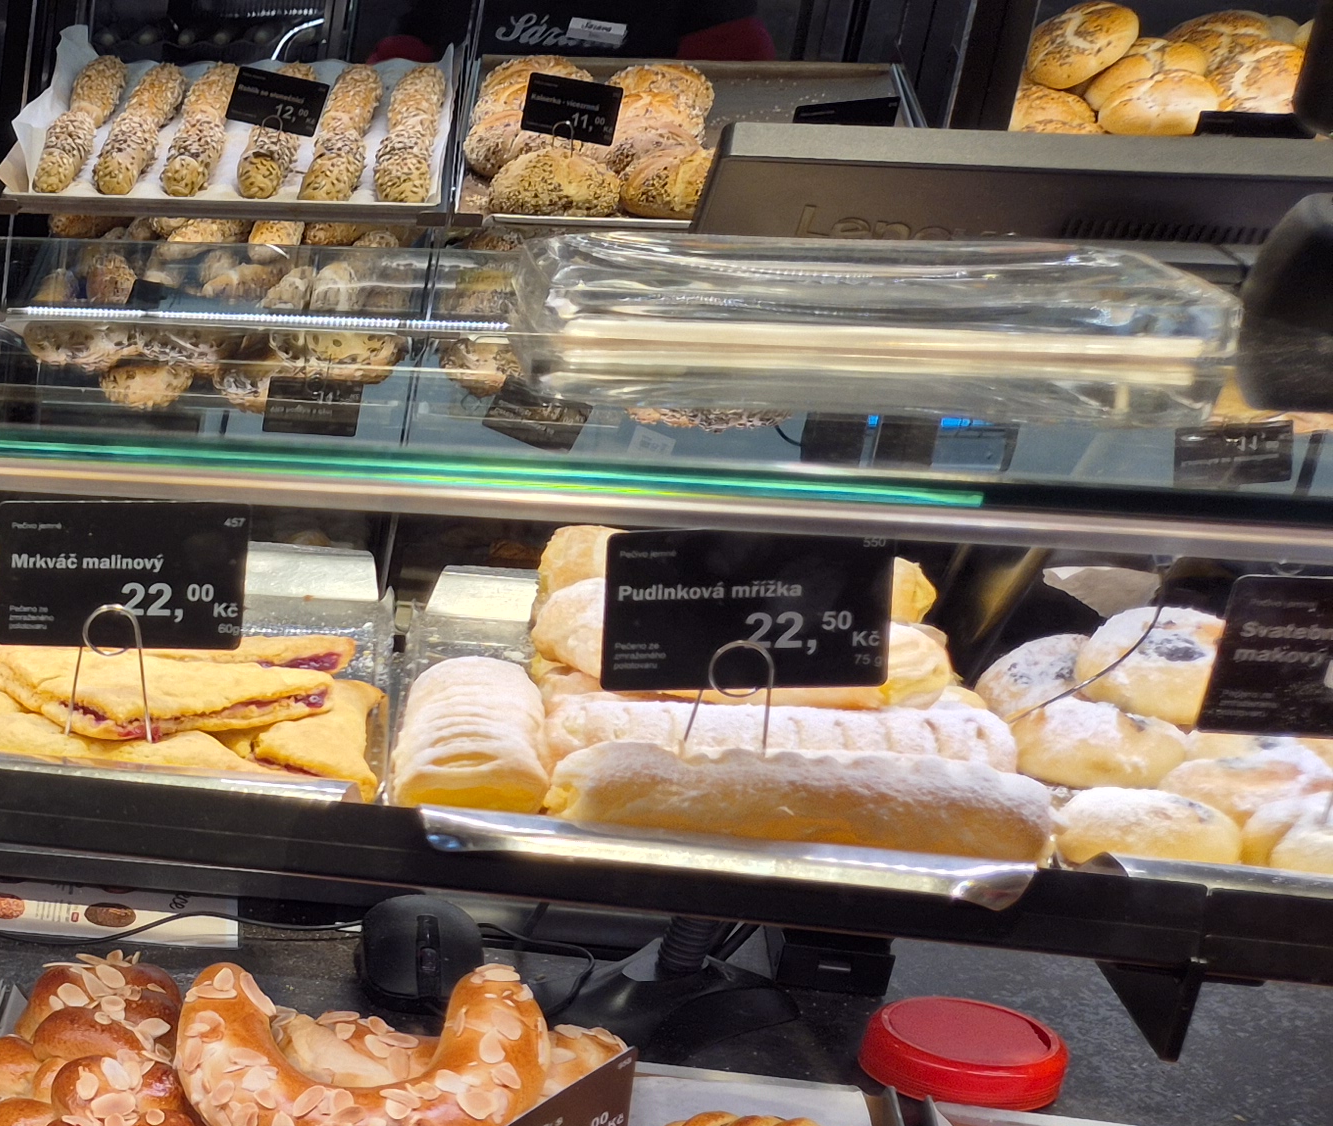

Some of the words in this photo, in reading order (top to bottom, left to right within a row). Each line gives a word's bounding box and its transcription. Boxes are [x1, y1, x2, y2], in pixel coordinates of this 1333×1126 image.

[275, 103, 309, 123] 12,00
[572, 112, 605, 132] 11,00
[11, 553, 78, 569] Mrkváč
[82, 554, 164, 572] malinový
[617, 582, 725, 601] Pudinková
[731, 580, 803, 599] mřížka
[120, 582, 214, 623] 22,00
[213, 603, 239, 618] Kč
[744, 610, 853, 655] 22,50
[852, 631, 881, 647] Kč
[555, 1117, 564, 1126] s
